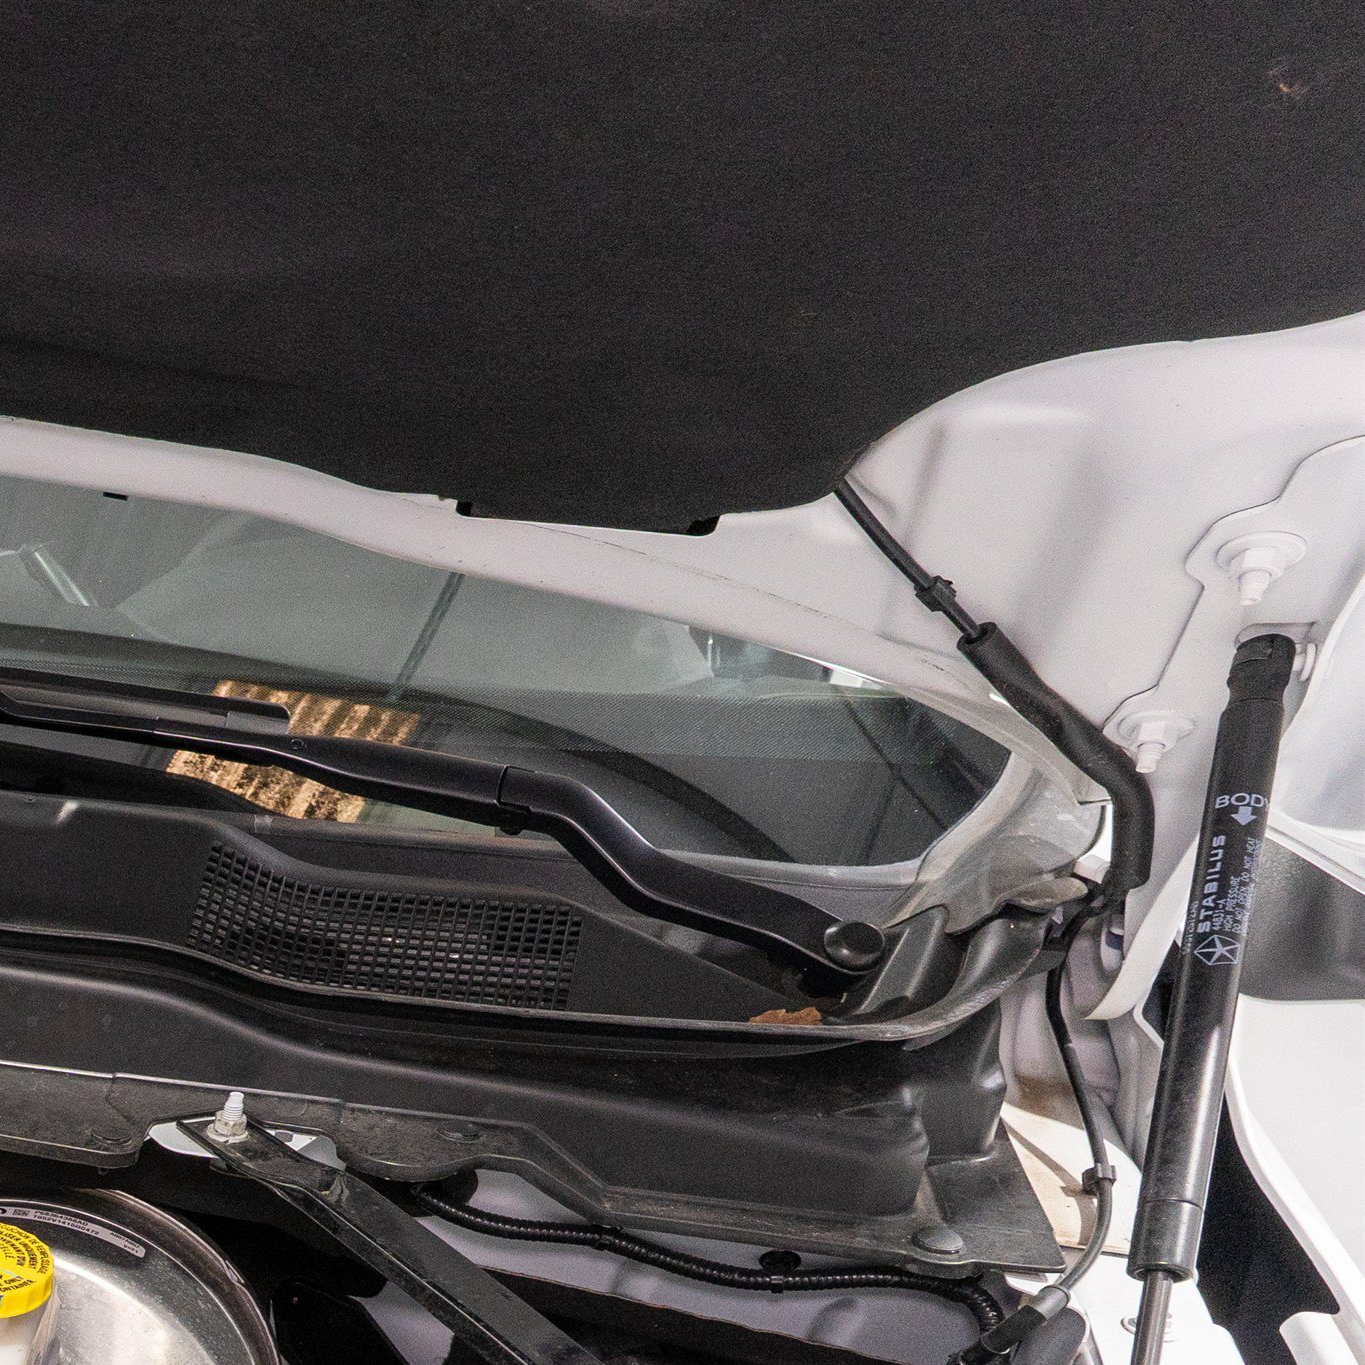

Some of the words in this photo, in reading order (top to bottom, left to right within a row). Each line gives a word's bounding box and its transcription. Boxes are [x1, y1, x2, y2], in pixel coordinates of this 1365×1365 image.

[1197, 835, 1226, 933] STABILUS
[1225, 876, 1241, 912] PRESSURE
[4, 1276, 24, 1284] ONLY
